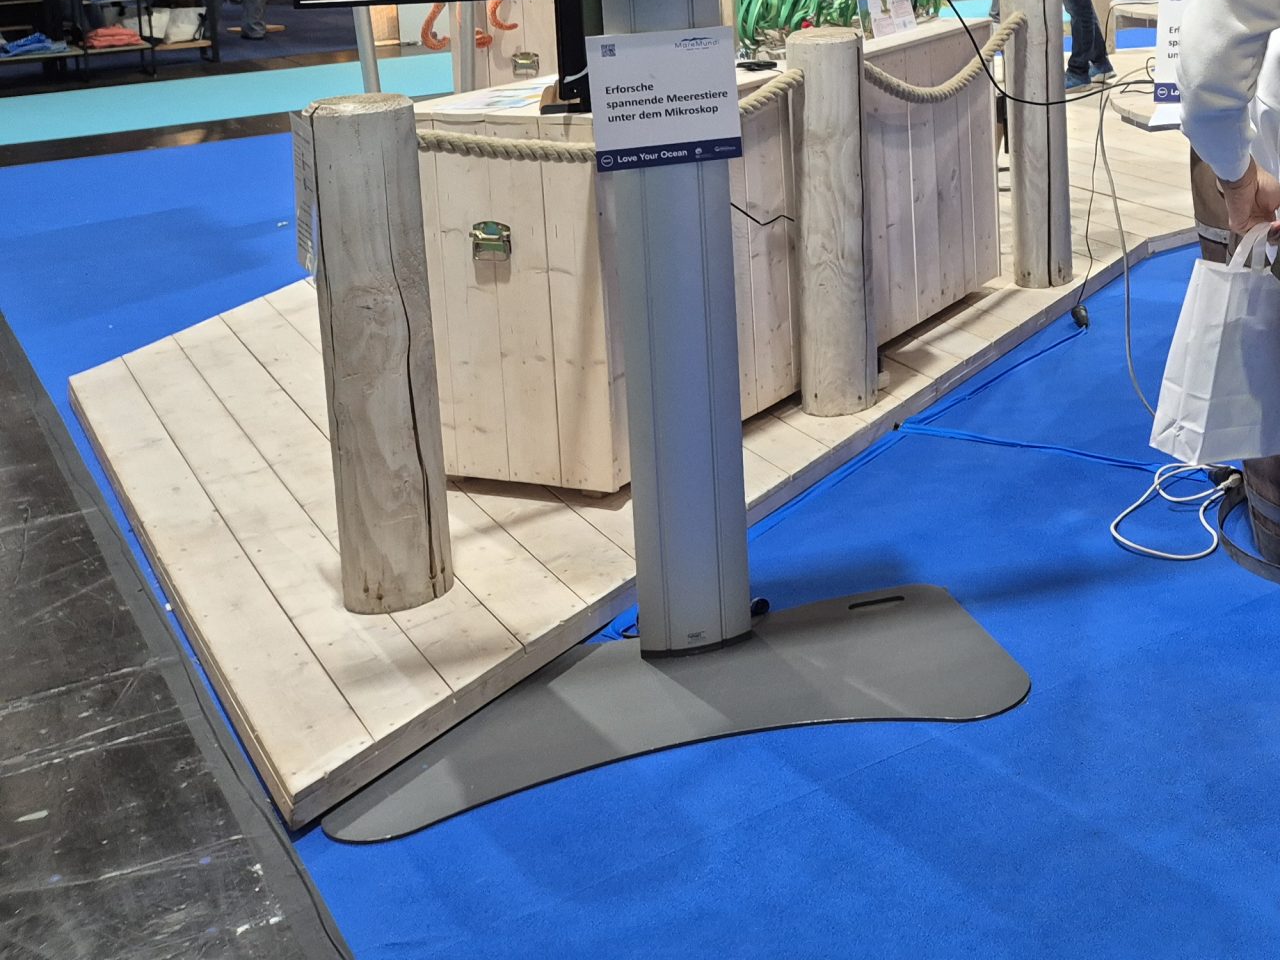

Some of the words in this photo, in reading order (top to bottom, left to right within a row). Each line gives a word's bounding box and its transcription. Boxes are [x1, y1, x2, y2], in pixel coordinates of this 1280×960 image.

[605, 82, 654, 95] Erforsche
[606, 95, 664, 110] spannende
[666, 90, 728, 103] Meerestiere
[608, 112, 636, 123] unter
[638, 109, 662, 120] dem
[664, 104, 719, 118] Mikroskop
[617, 155, 638, 163] Love
[639, 152, 659, 160] Your
[660, 149, 688, 159] Ocean
